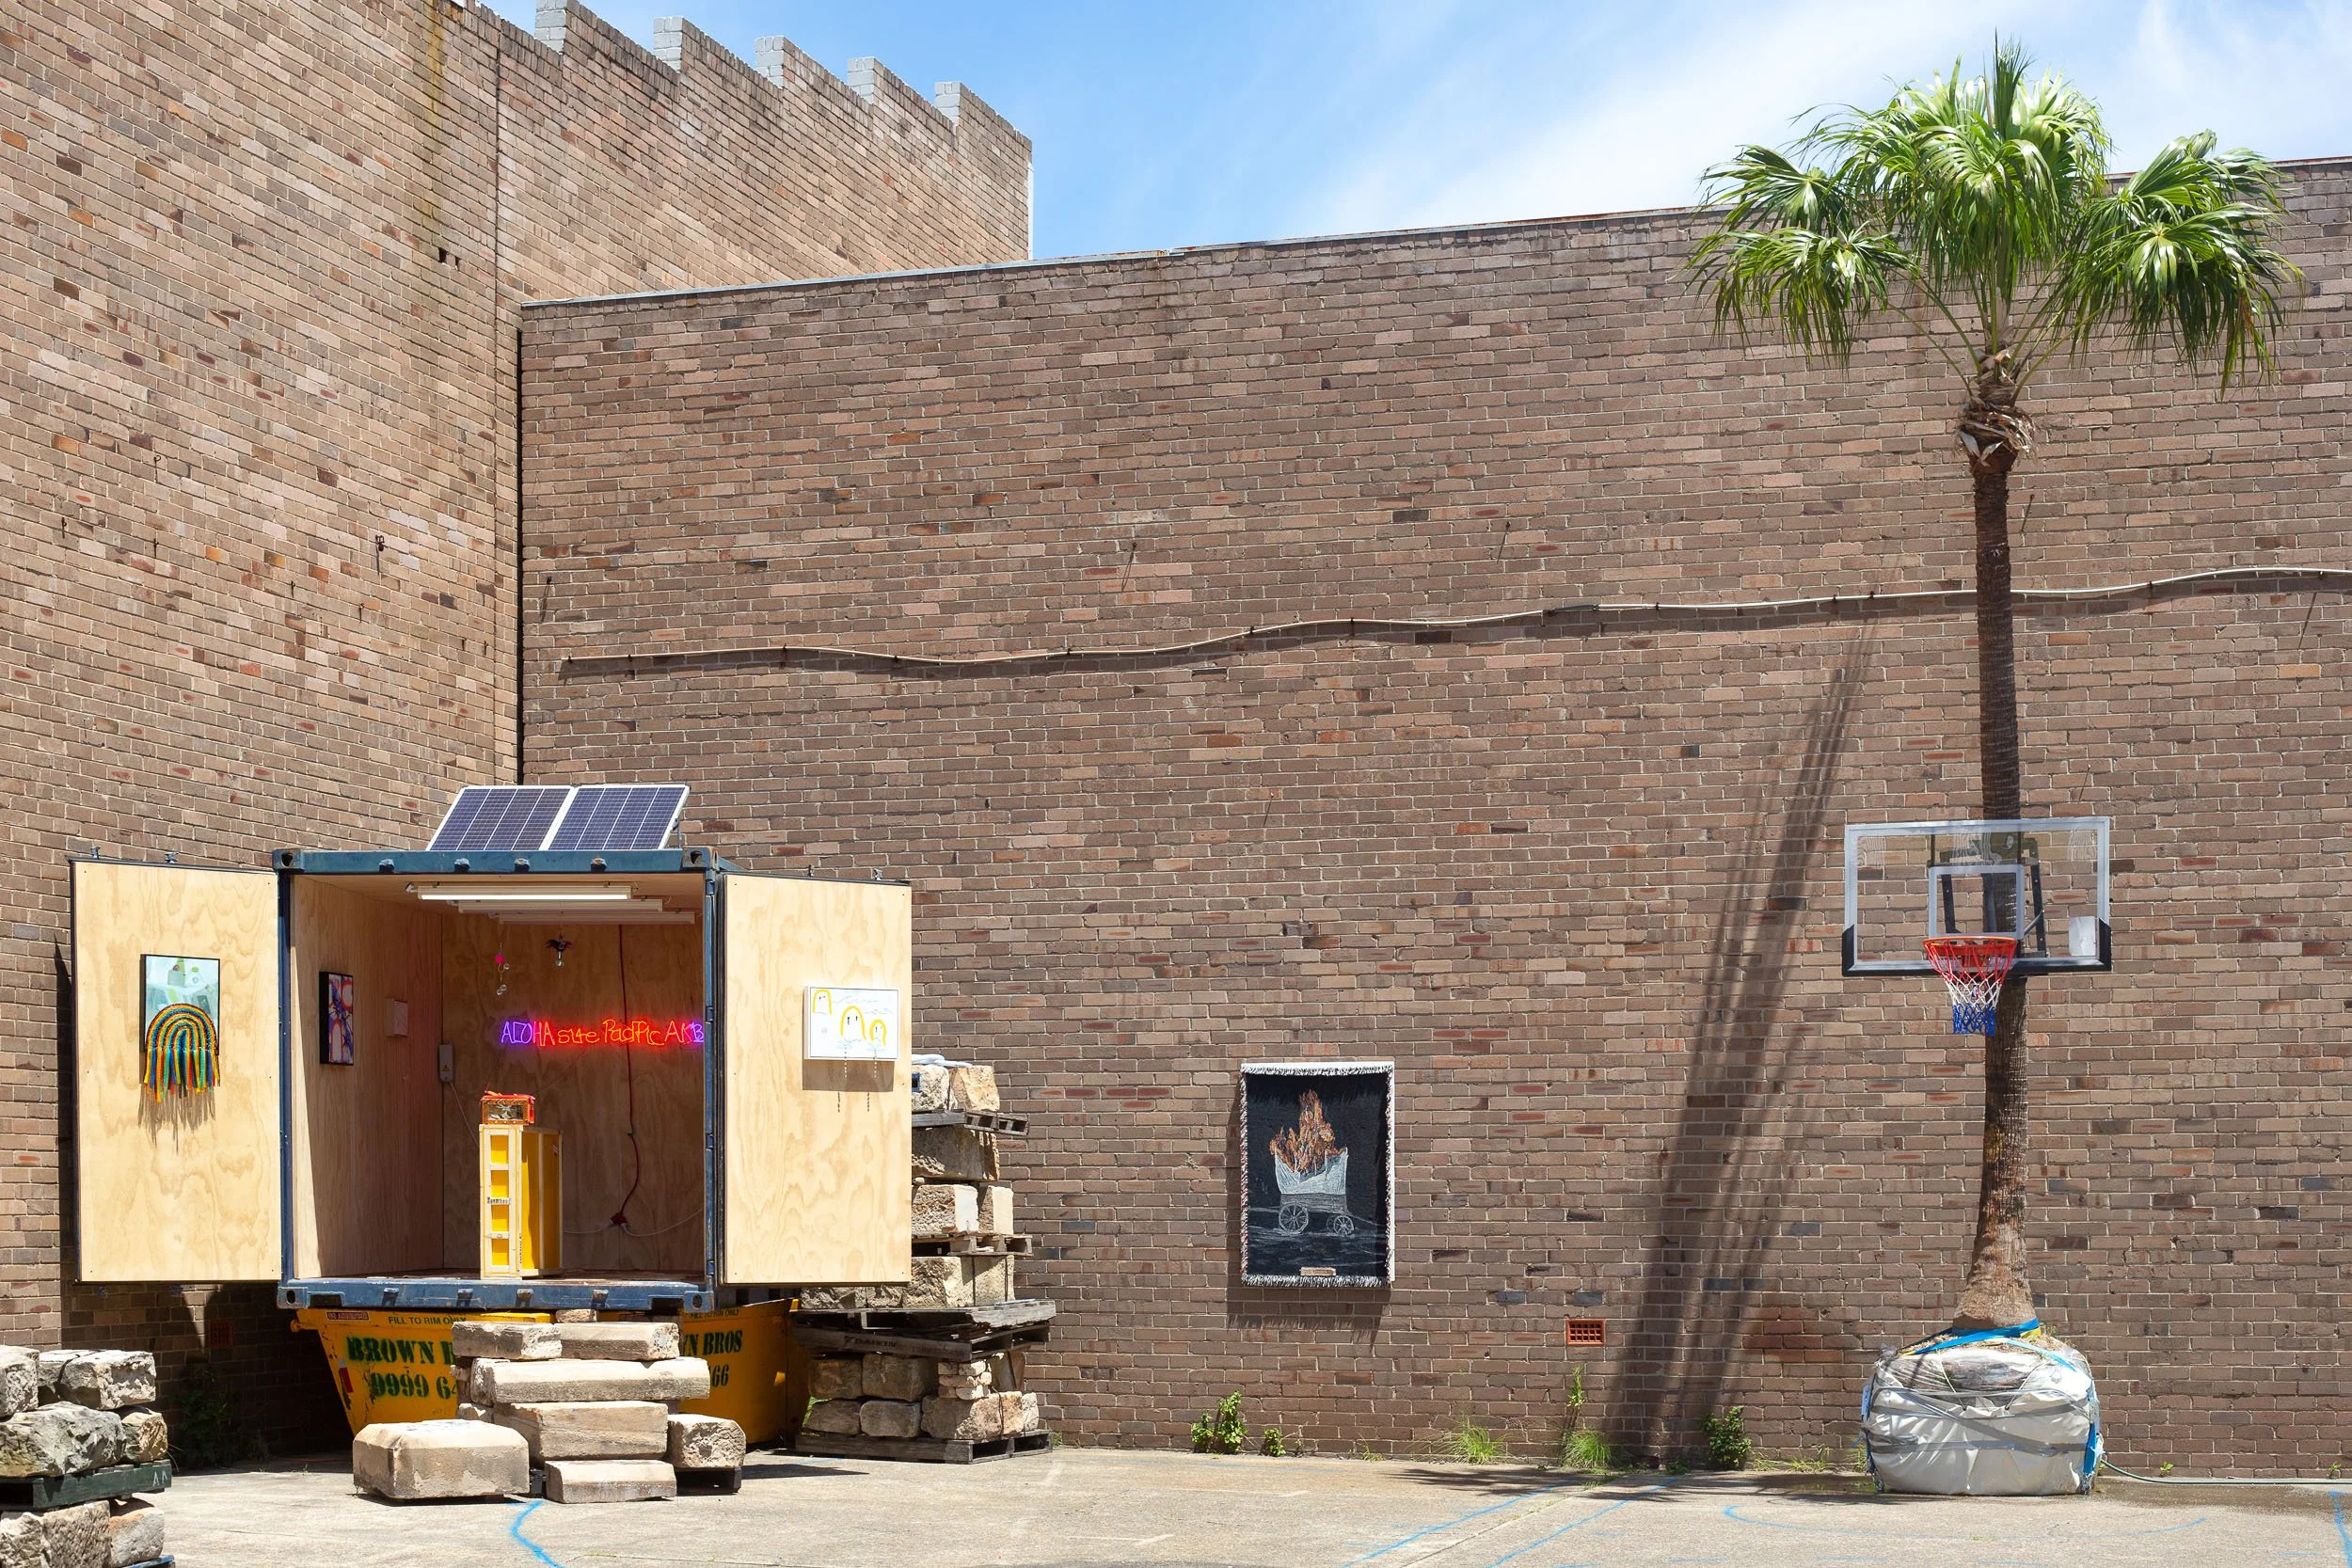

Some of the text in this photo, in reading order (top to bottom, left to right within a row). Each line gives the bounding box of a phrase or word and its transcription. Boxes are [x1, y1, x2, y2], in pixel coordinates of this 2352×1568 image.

[557, 1027, 600, 1044] site
[388, 1316, 406, 1324] FILL
[424, 1317, 441, 1325] RIM
[346, 1336, 435, 1364] BROWN
[703, 1330, 742, 1355] BROS
[371, 1372, 430, 1399] 9999
